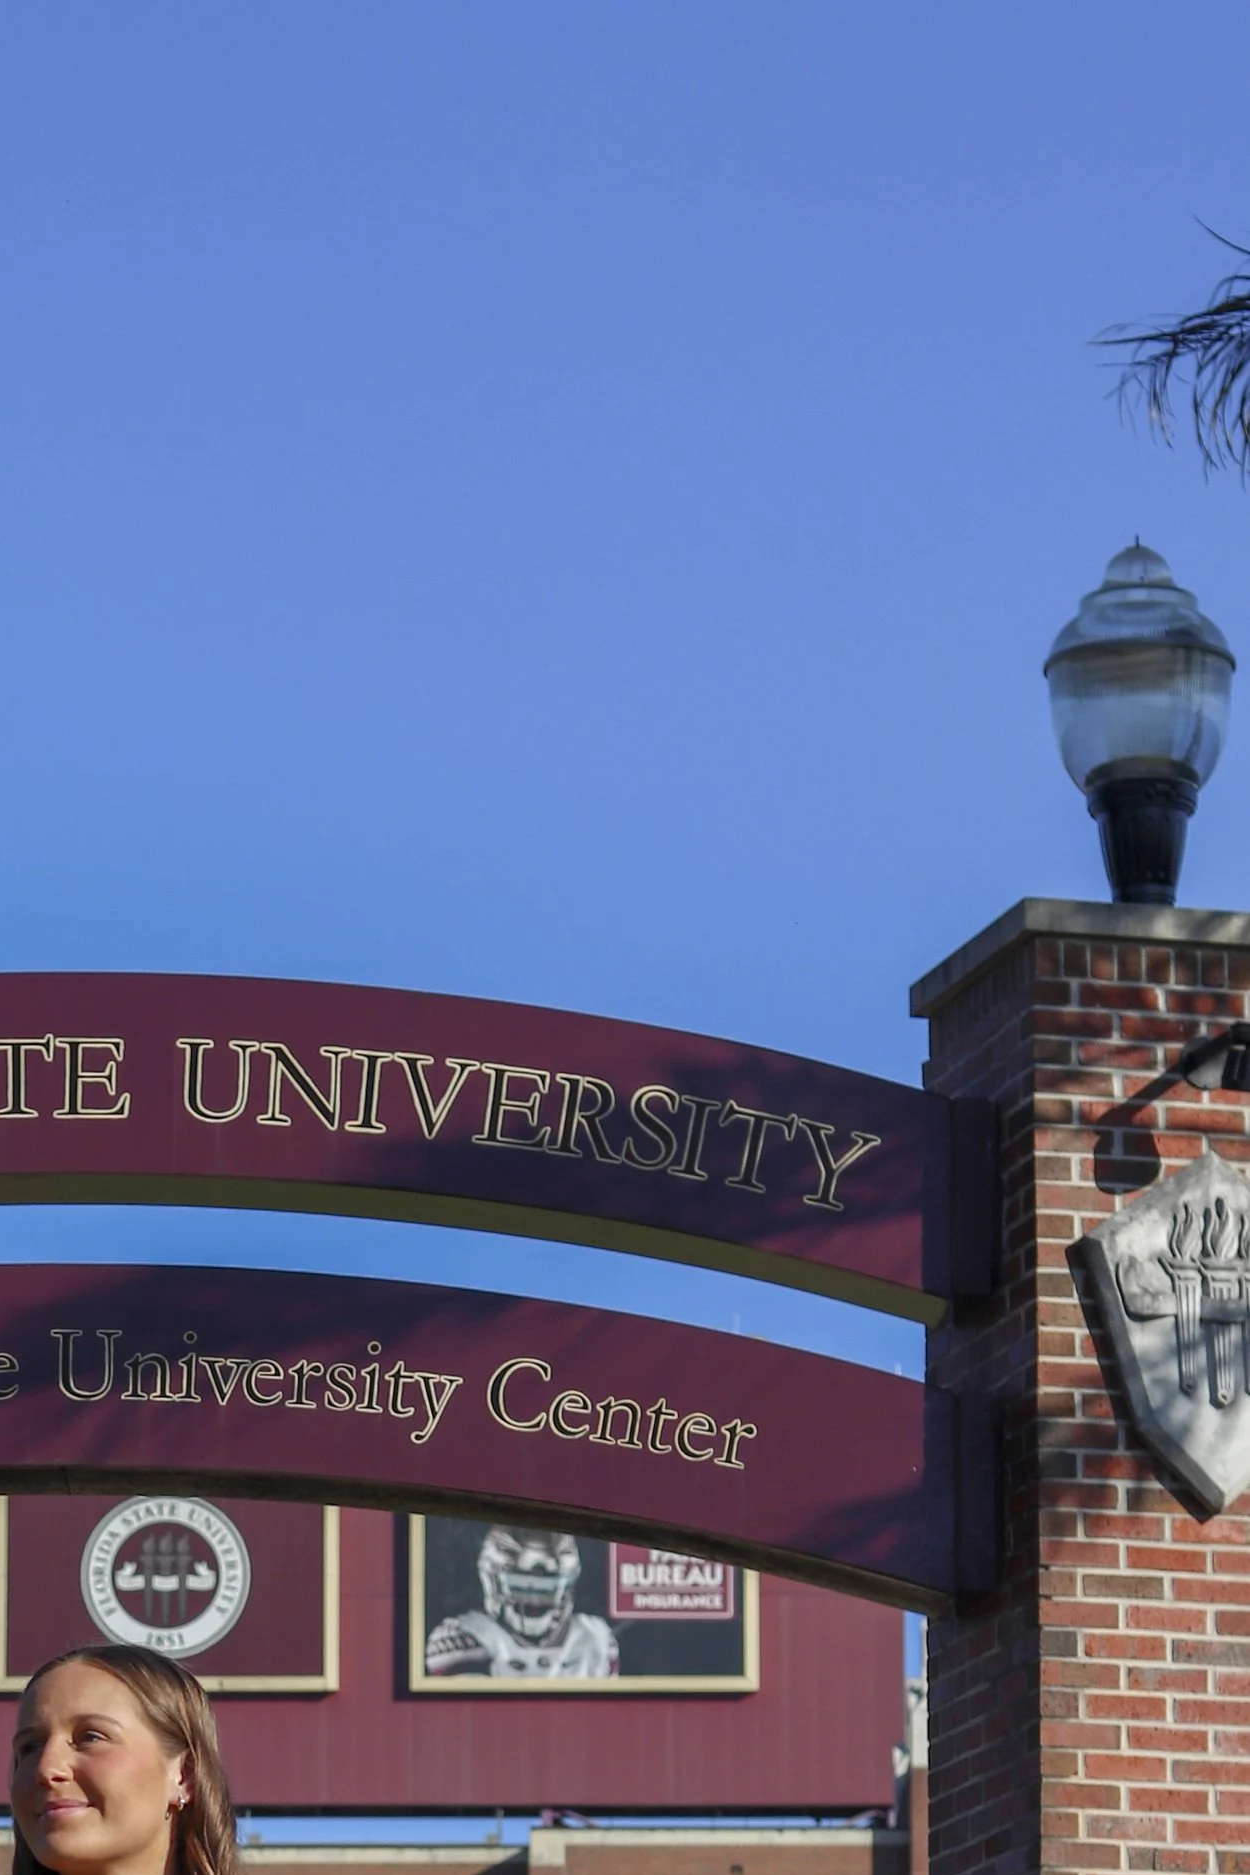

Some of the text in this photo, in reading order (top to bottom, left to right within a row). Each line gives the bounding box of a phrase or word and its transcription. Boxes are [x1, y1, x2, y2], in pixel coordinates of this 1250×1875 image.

[176, 1038, 881, 1211] UNIVERSITY
[50, 1330, 463, 1443] University
[487, 1358, 757, 1469] Center
[91, 1503, 238, 1618] FLORIDA STATE UNIVERSITY
[620, 1562, 723, 1586] BUREAU
[633, 1594, 723, 1609] INSURANCE
[146, 1632, 185, 1647] 1851
